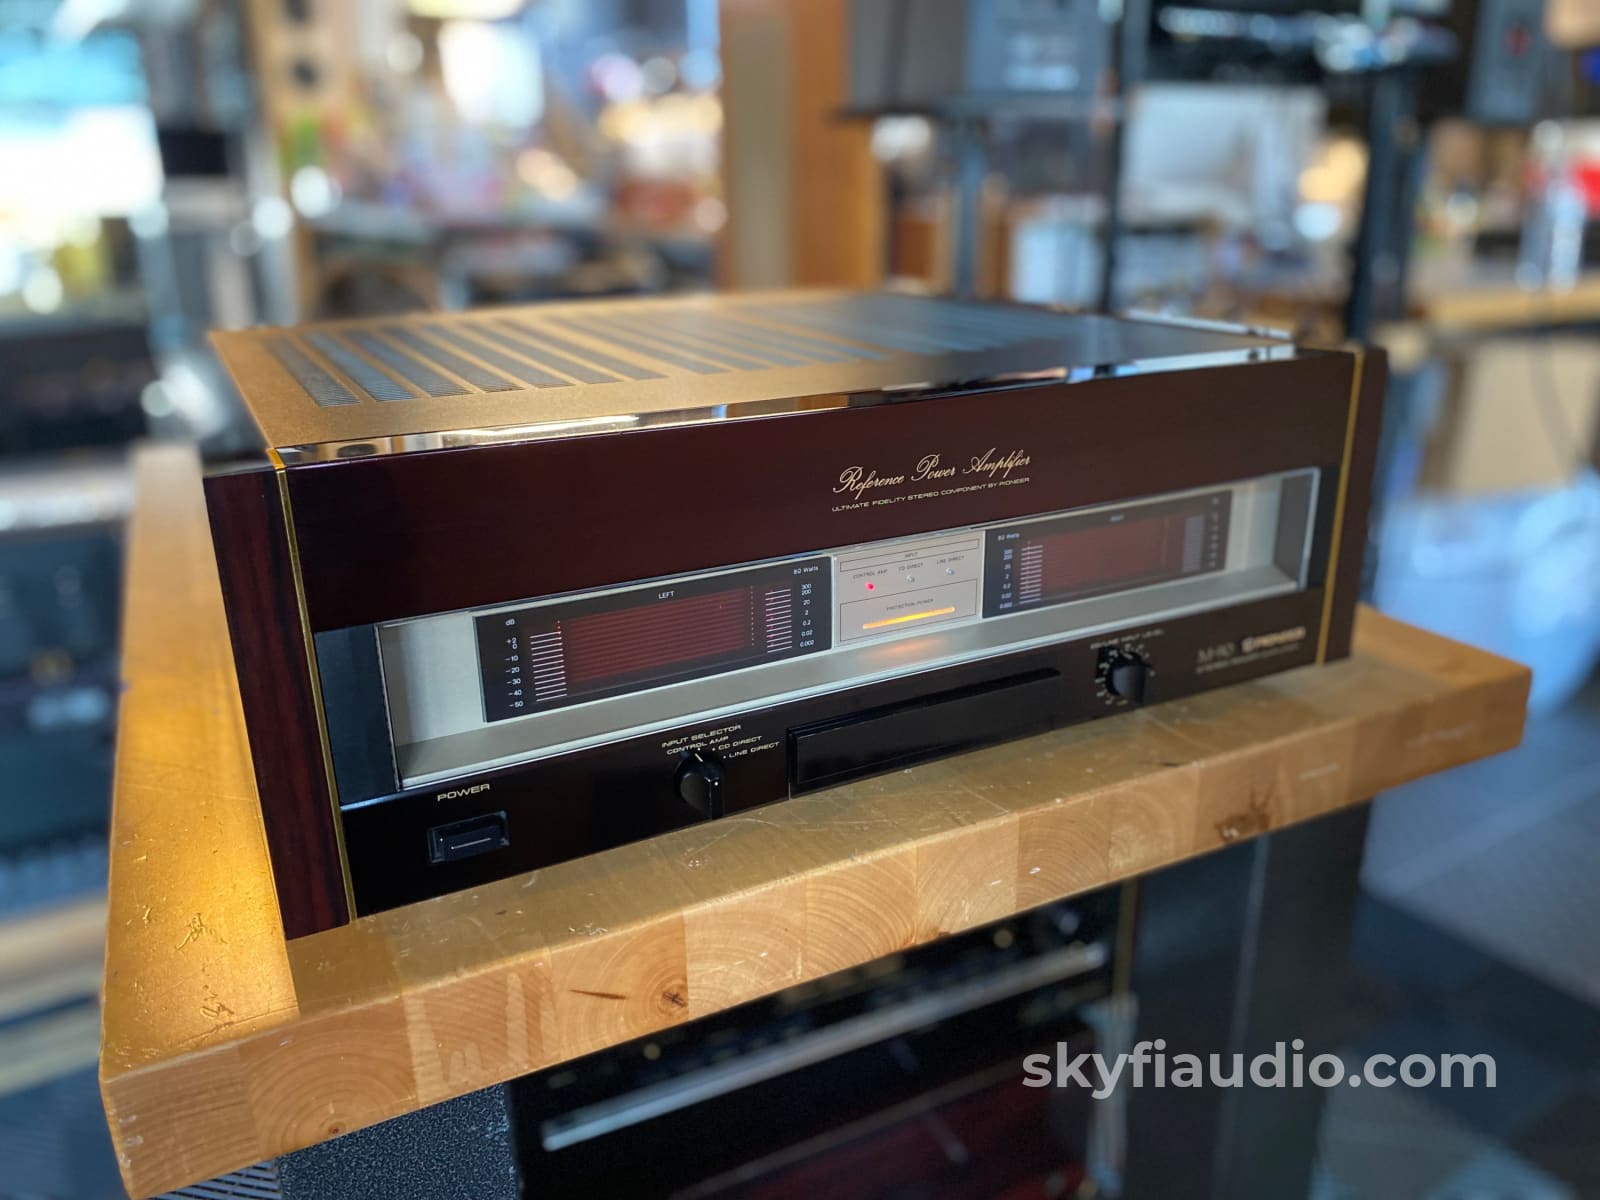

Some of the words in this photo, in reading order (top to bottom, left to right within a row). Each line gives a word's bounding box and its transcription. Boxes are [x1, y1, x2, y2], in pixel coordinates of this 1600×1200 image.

[832, 466, 905, 500] Reference
[911, 454, 957, 482] Power
[963, 447, 1031, 479] Amplifier
[831, 501, 870, 512] ULTIMATE
[872, 496, 906, 507] FIDELITY
[907, 491, 940, 501] STEREO
[940, 483, 987, 496] COMPONENT
[987, 481, 998, 489] BY
[658, 590, 675, 599] LEFT
[505, 618, 515, 626] dB
[661, 737, 689, 749] INPUT
[690, 724, 742, 741] SELECTOR
[666, 741, 708, 756] CONTROL
[708, 735, 729, 745] AMP
[718, 743, 731, 751] CD
[732, 735, 763, 747] DIRECT
[728, 749, 748, 759] LINE
[750, 741, 780, 753] DIRECT
[436, 783, 490, 802] POWER
